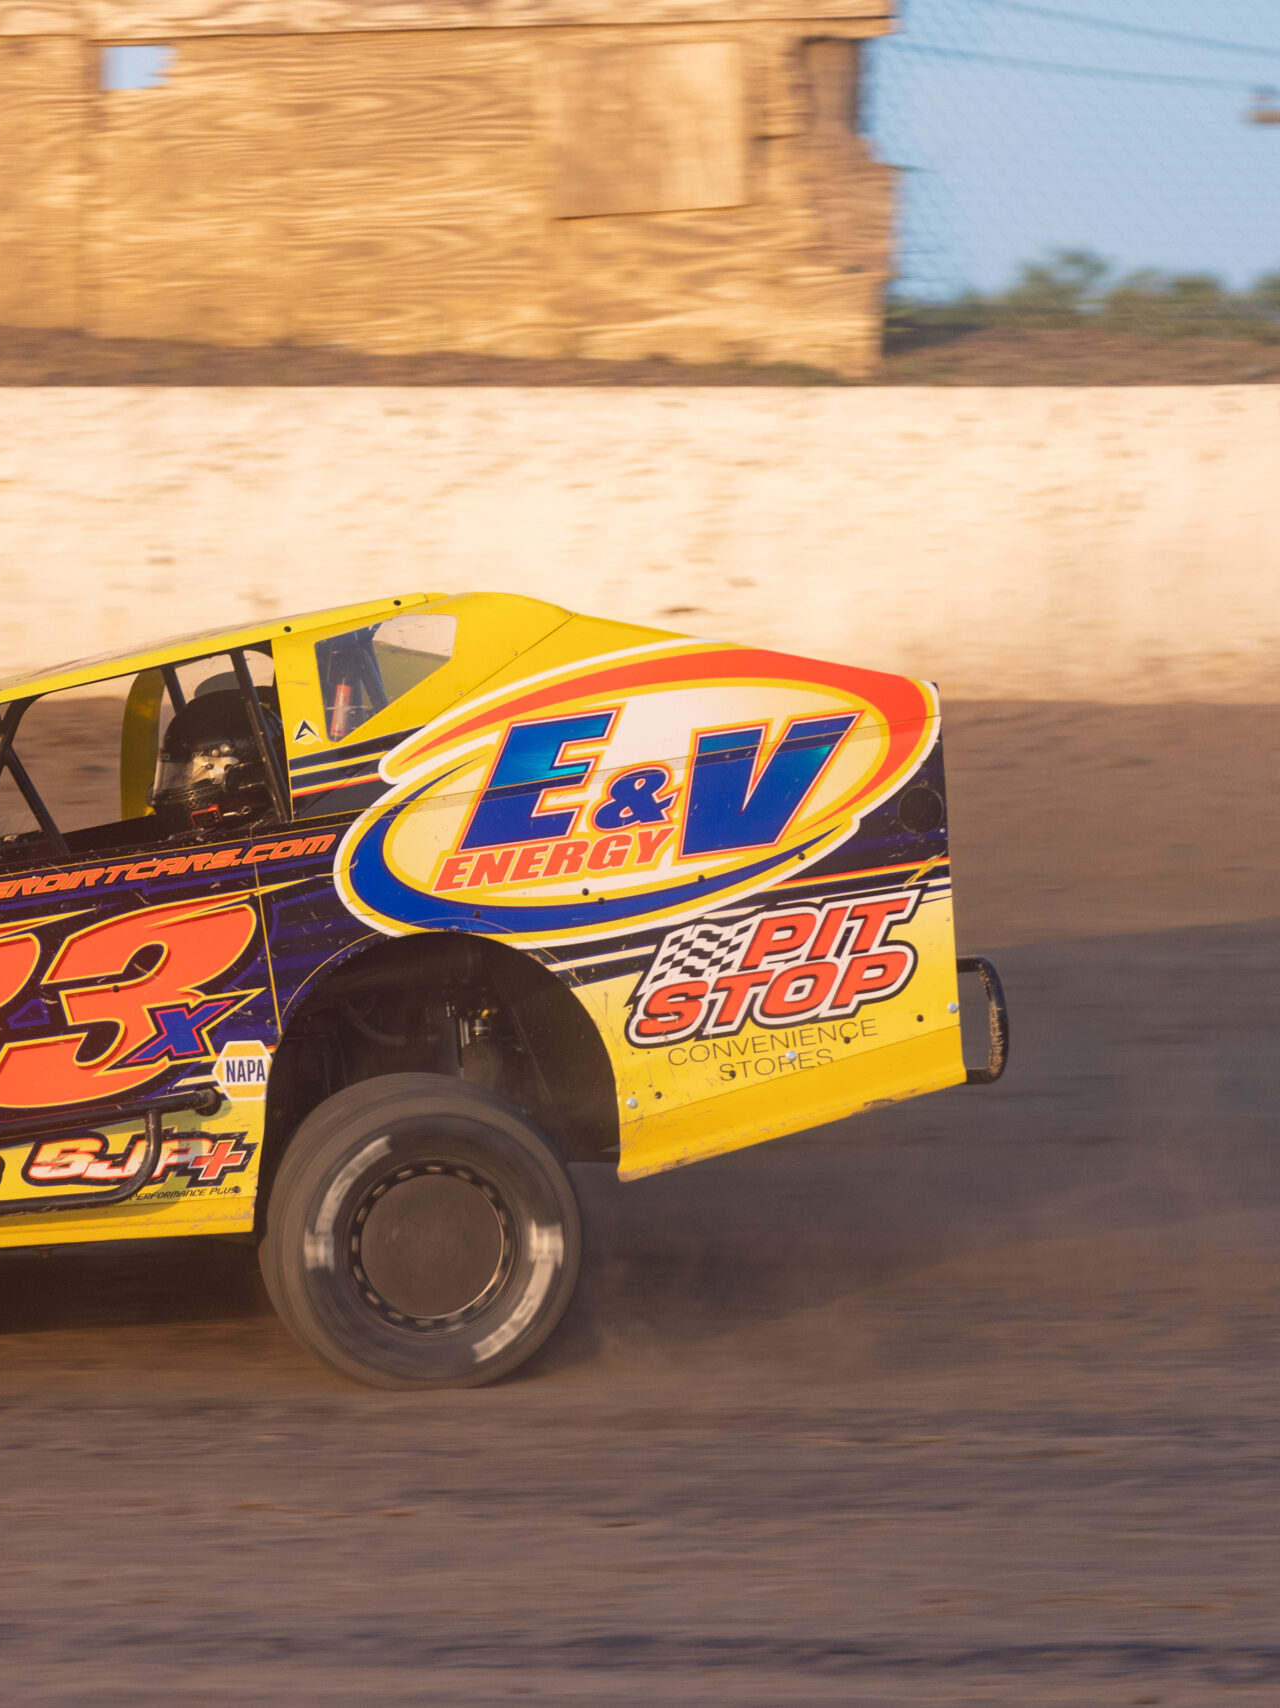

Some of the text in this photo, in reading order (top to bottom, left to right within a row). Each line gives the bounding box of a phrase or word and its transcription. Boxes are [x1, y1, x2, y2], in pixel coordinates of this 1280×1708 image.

[433, 827, 676, 893] ENERGY
[740, 896, 912, 969] PIT
[635, 950, 909, 1035] STOP
[667, 1018, 879, 1067] CONVENIENCE
[719, 1048, 835, 1082] STORES
[224, 1059, 267, 1083] NAPA
[129, 1186, 238, 1201] PERFORMANCE PLUS
